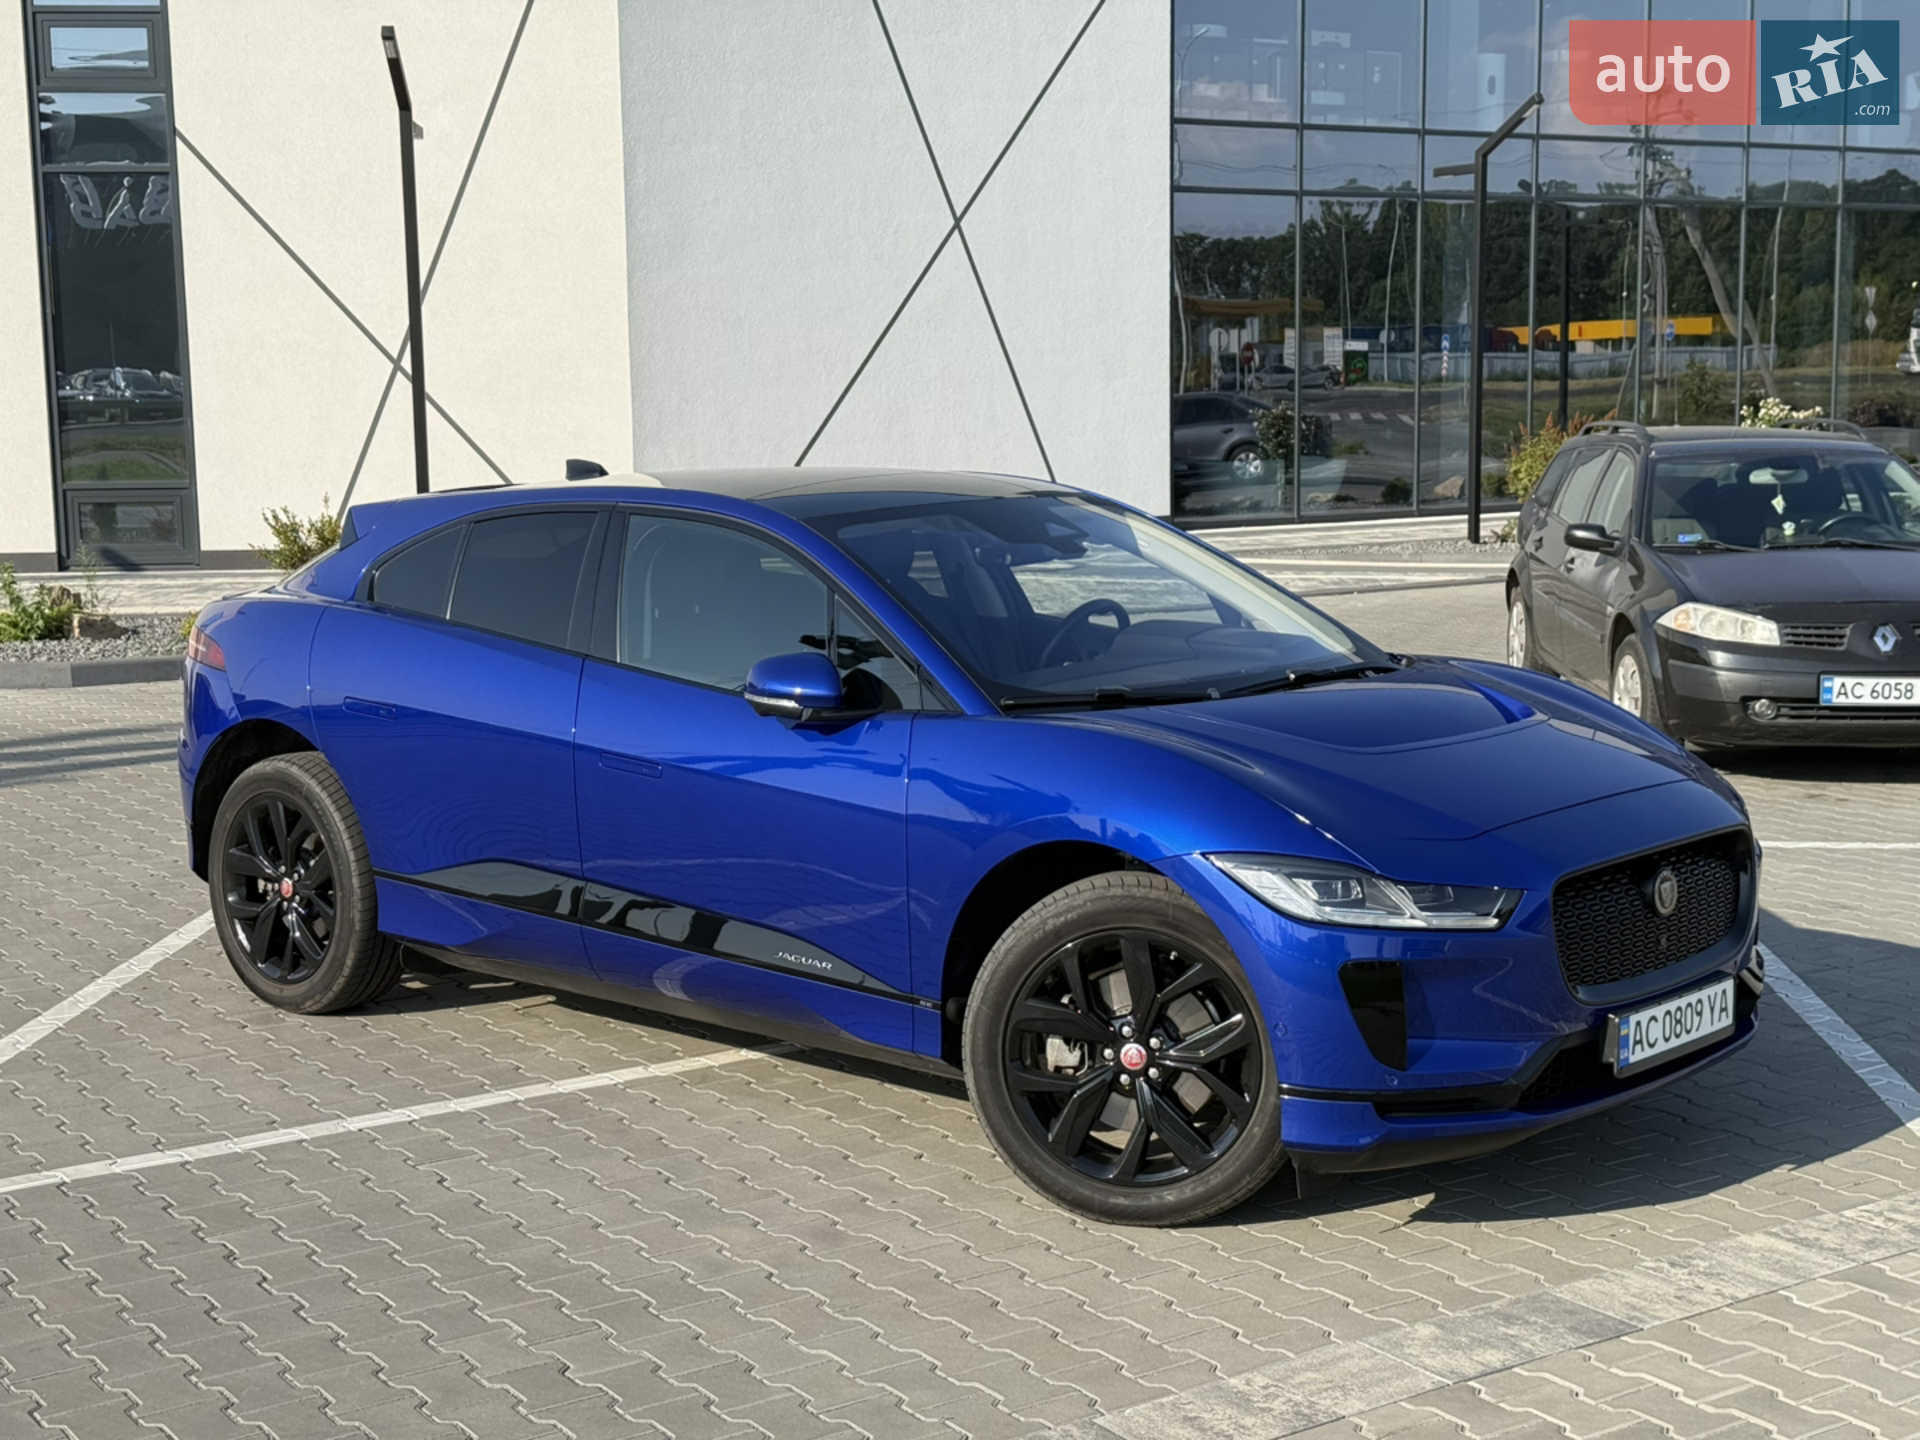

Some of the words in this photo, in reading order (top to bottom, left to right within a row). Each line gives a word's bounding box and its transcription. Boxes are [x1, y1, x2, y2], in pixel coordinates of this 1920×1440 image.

[1836, 681, 1865, 699] AC
[1870, 681, 1914, 700] 6058
[773, 951, 832, 971] JAGUAR
[1631, 1015, 1659, 1056] AC
[1662, 998, 1704, 1043] 0809
[1707, 988, 1729, 1027] YA
